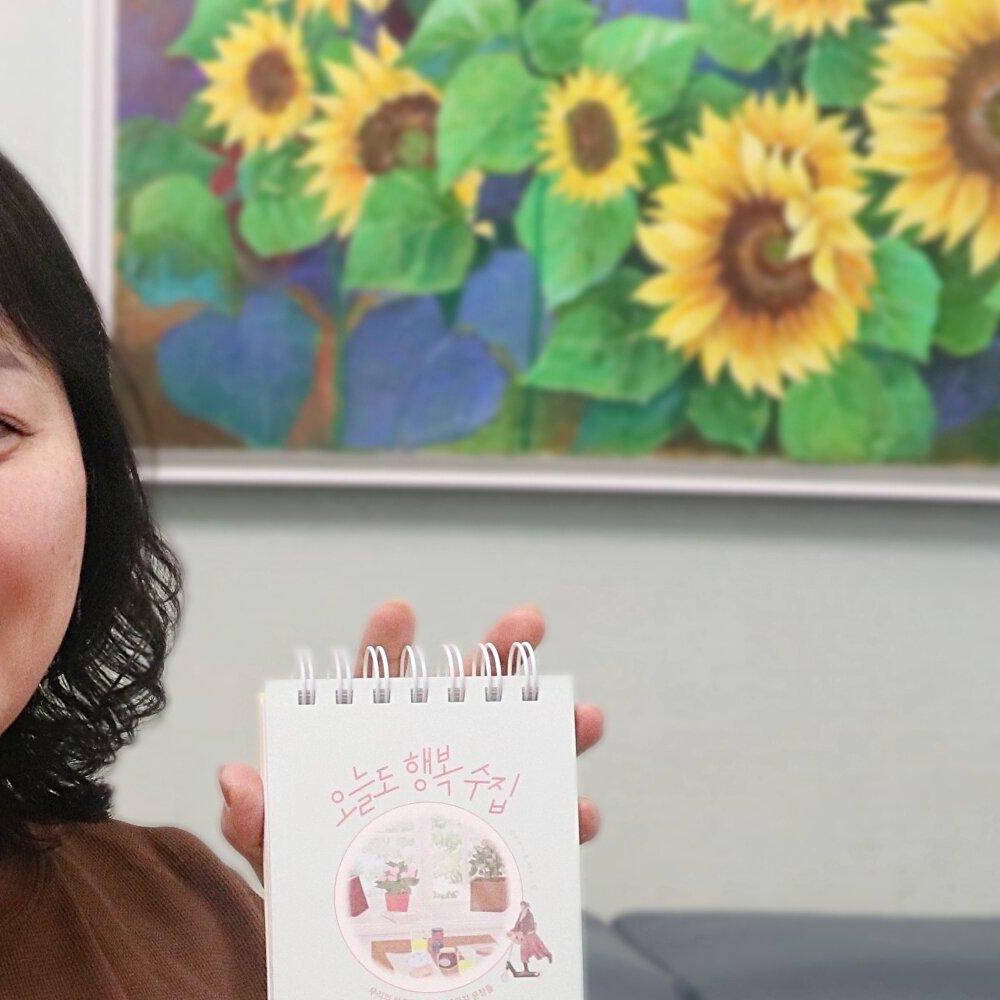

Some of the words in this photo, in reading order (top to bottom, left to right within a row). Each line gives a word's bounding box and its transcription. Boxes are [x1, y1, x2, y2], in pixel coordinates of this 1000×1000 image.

[331, 766, 400, 827] 오늘도
[403, 745, 464, 797] 행복
[464, 763, 521, 814] 수집
